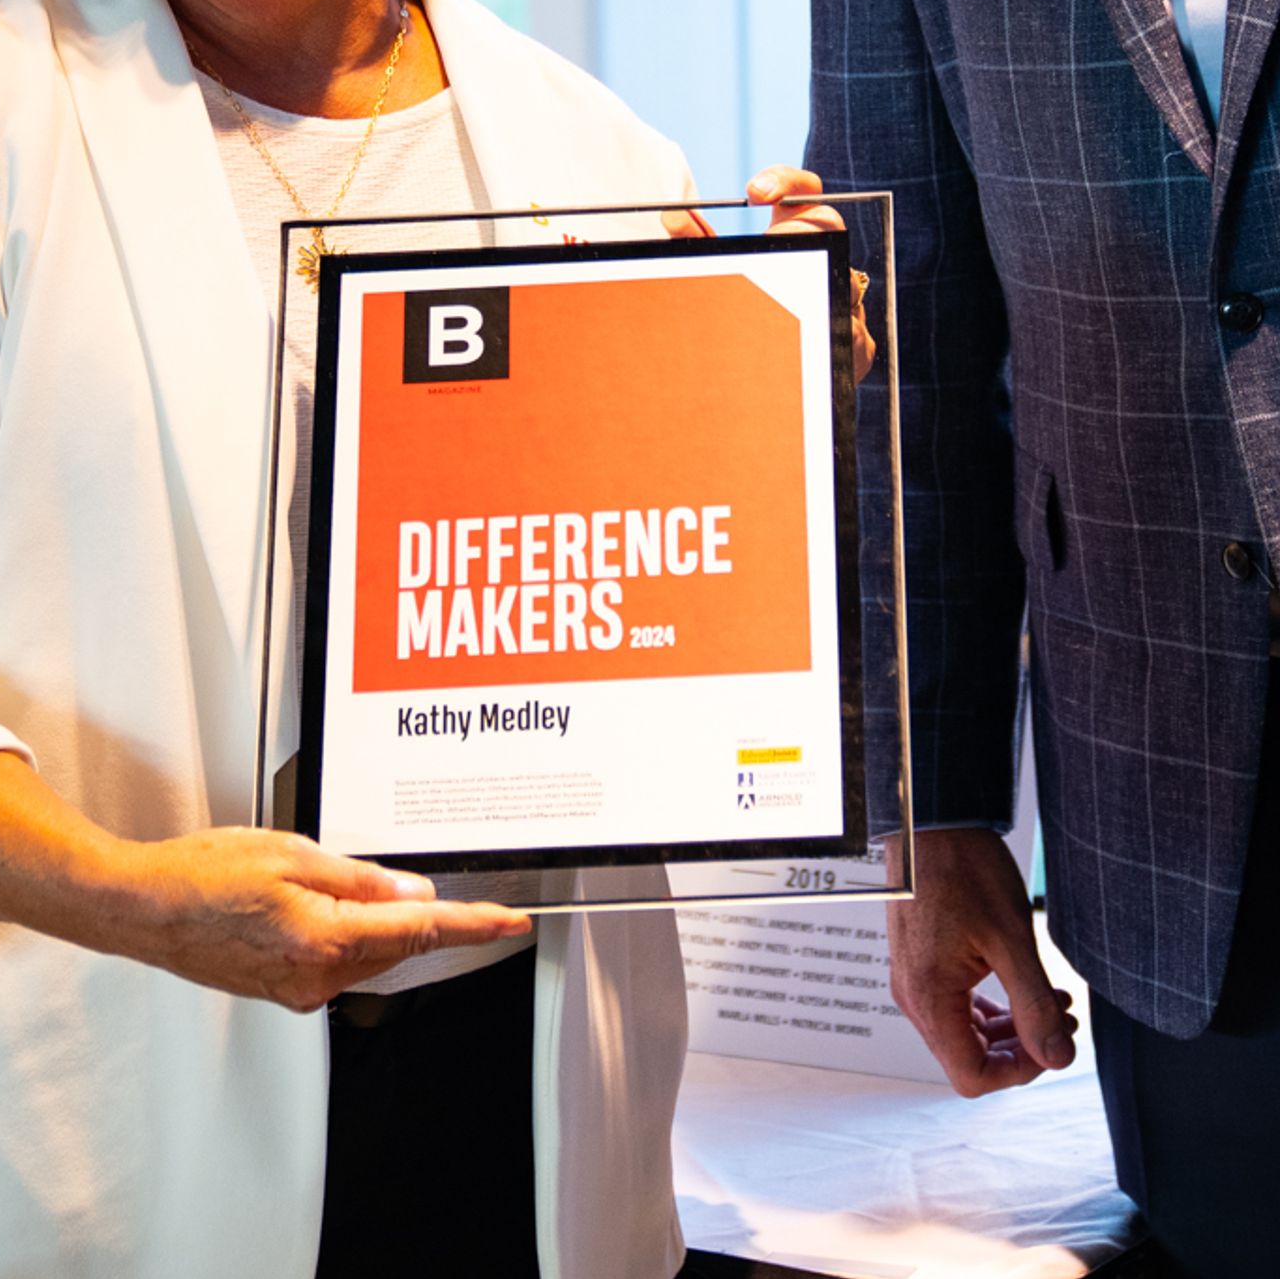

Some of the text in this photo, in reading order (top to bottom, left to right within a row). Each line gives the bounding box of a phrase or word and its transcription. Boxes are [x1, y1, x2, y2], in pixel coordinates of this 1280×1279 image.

[428, 304, 484, 366] B
[427, 385, 482, 395] MAGAZINE
[399, 505, 733, 589] DIFFERENCE
[397, 580, 676, 660] MAKERS 2024
[398, 700, 570, 742] Kathy Medley
[785, 867, 836, 891] 2019
